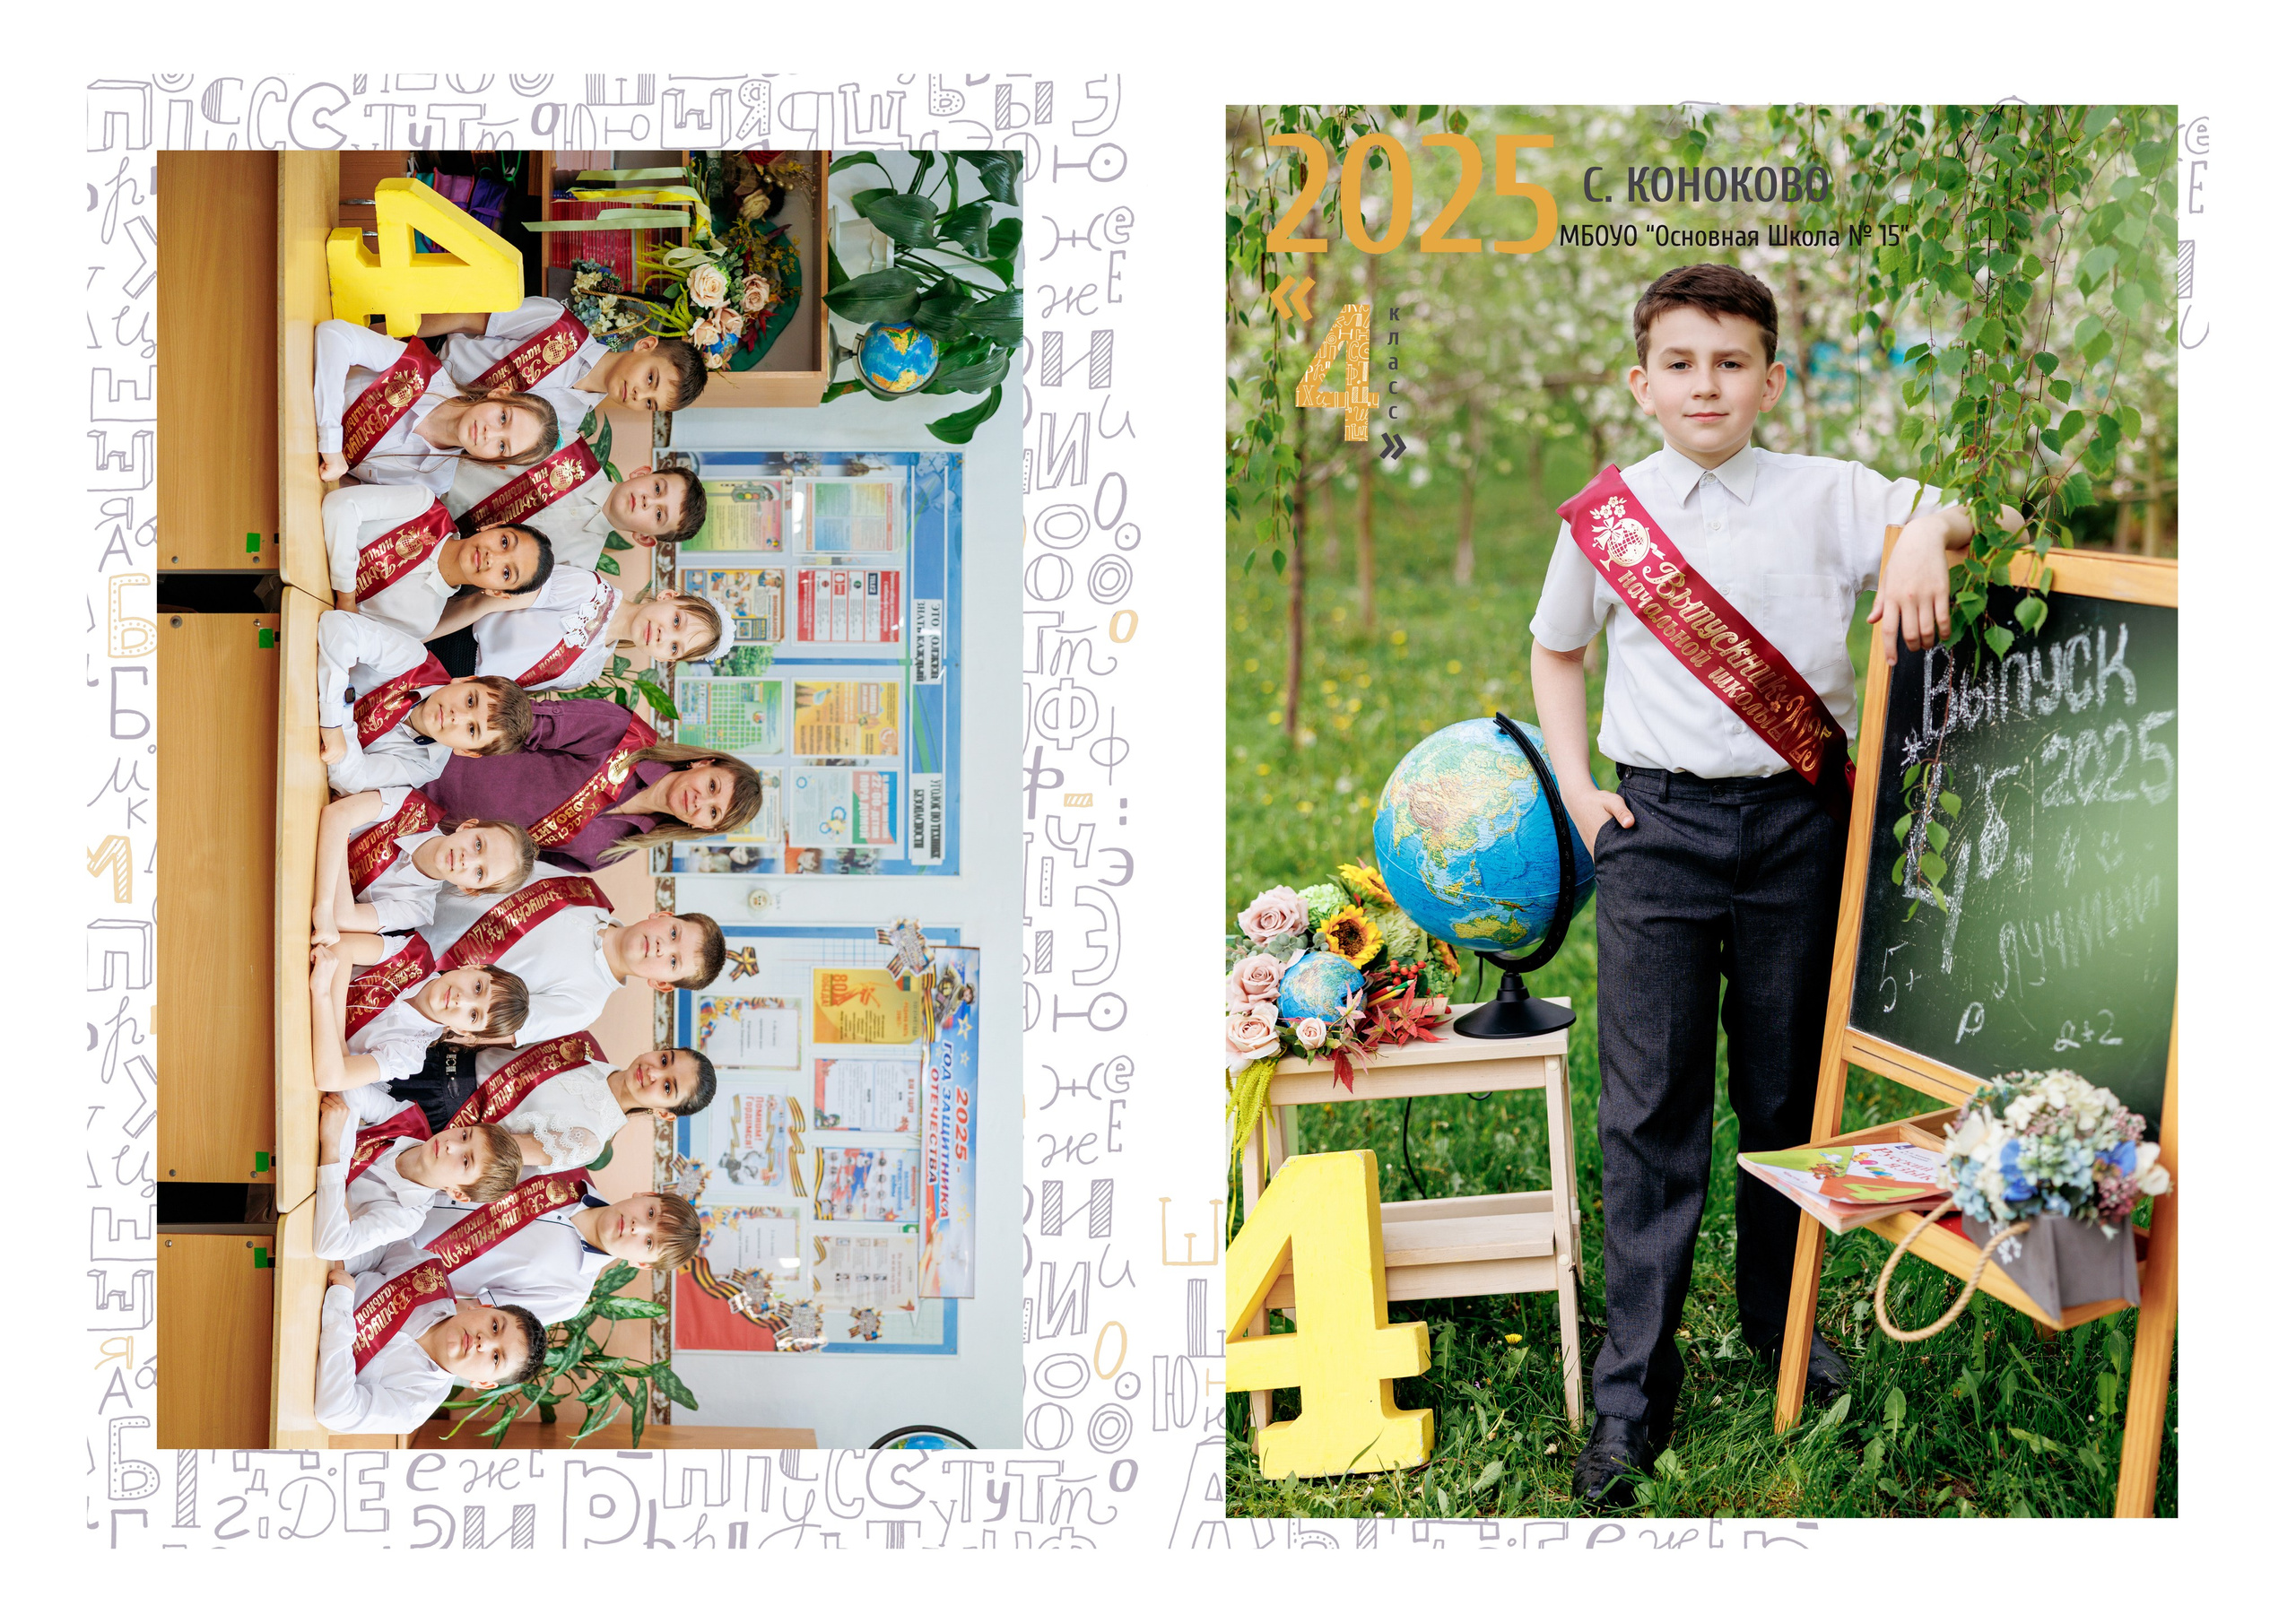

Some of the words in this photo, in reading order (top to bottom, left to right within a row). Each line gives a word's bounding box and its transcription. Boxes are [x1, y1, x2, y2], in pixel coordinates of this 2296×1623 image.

[326, 178, 526, 337] 4
[916, 601, 925, 633] ЗНАТЬ
[931, 603, 940, 626] ЭТО
[1642, 561, 1788, 700] Выпускник
[915, 635, 926, 681] КАЖДЫЙ
[930, 629, 940, 680] ОЛЖЕН
[1618, 569, 1713, 668] начальной
[1708, 665, 1778, 730] школы
[1767, 695, 1832, 772] 2025
[2041, 710, 2175, 806] 2025
[859, 775, 869, 801] ПОРА
[930, 779, 941, 810] УГОЛОК
[858, 802, 870, 839] ДОМОЙ
[913, 789, 924, 849] БЕЗОПАСНОСТИ
[930, 812, 941, 822] ПО
[930, 824, 941, 859] ТЕХНИКЕ
[832, 974, 848, 992] 80
[484, 1053, 562, 1116] Выпускник
[503, 1042, 559, 1079] начальной
[942, 1040, 952, 1083] ГОД
[744, 1096, 753, 1150] Гордимся!
[755, 1097, 764, 1141] Помним!
[928, 1067, 940, 1185] ОТЕЧЕСТВА
[956, 1087, 969, 1161] 2025
[940, 1087, 952, 1220] ЗАЩИТНИКА
[1870, 1147, 1935, 1173] Русский
[488, 1179, 546, 1219] начальной
[459, 1193, 545, 1257] Выпускник
[354, 1276, 411, 1327] начальной
